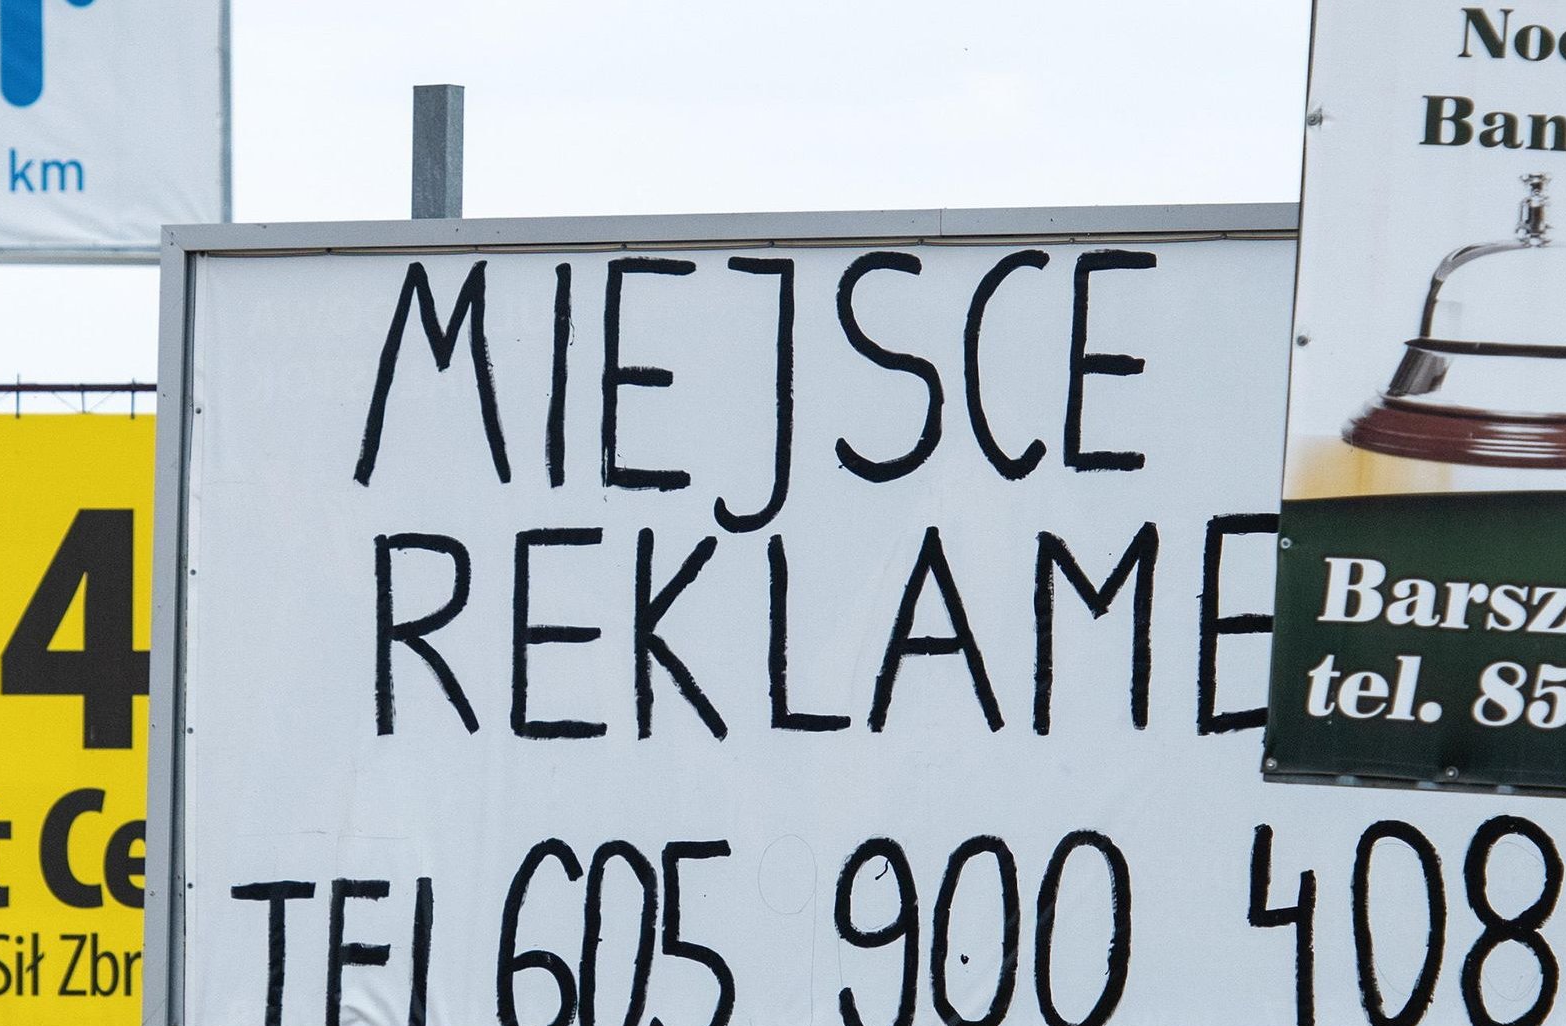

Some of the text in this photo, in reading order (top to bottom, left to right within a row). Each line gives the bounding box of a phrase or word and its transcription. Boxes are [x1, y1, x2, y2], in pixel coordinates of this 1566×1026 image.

[8, 148, 85, 193] km
[353, 248, 1158, 533] MIEJSCE
[0, 508, 152, 750] 4
[1307, 654, 1442, 723] tel.
